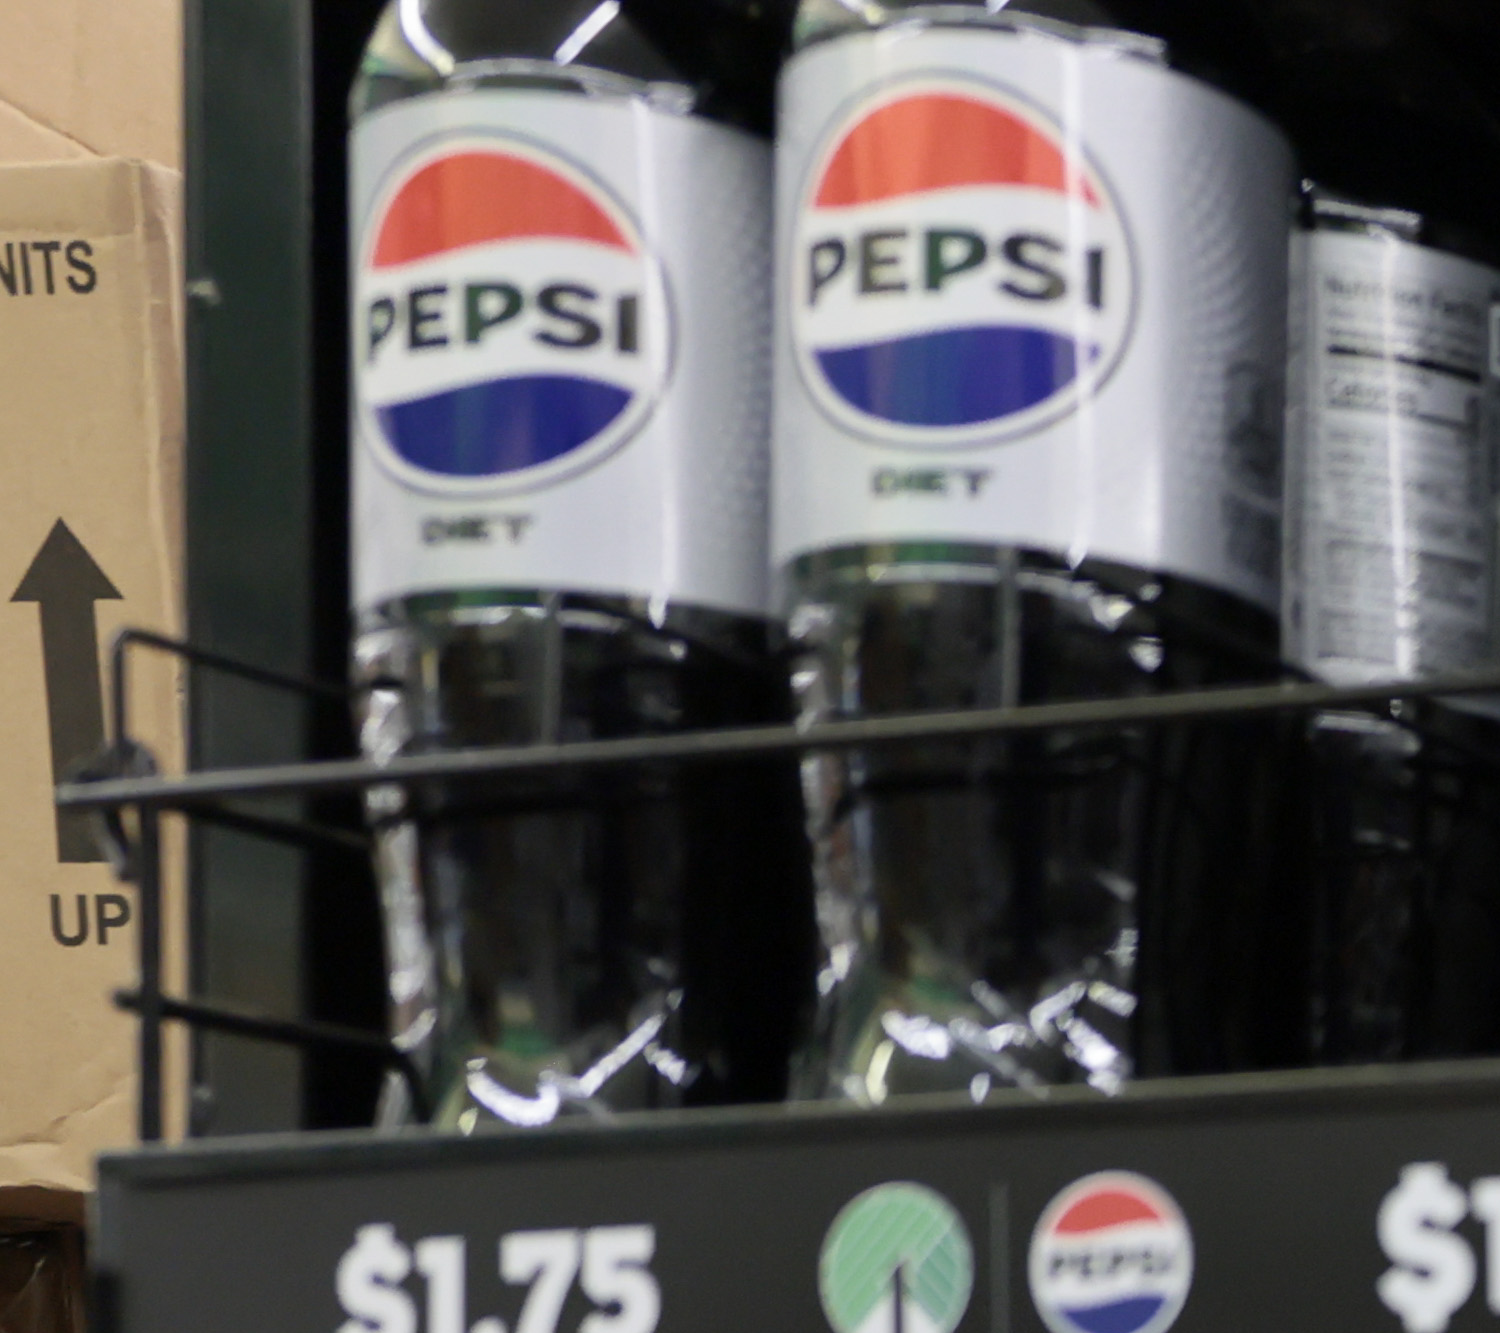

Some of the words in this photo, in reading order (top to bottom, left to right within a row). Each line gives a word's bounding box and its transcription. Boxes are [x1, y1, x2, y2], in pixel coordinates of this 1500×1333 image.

[805, 225, 1106, 312] PEPSI
[366, 279, 643, 366] PEPSI
[50, 893, 132, 947] UP
[1045, 1246, 1181, 1284] PEPSI
